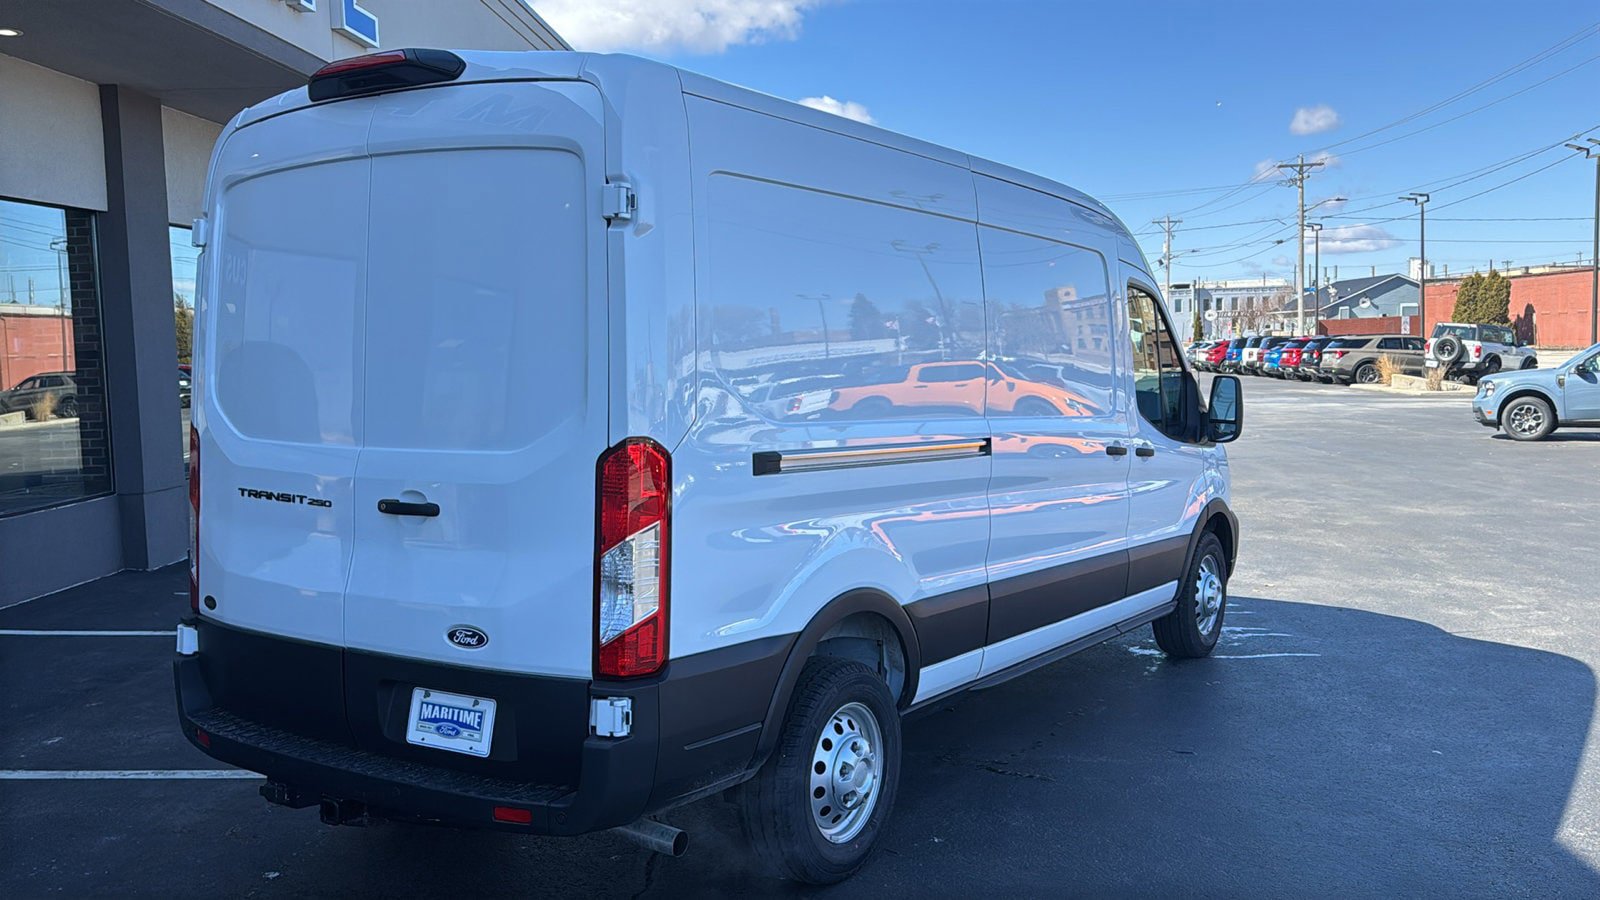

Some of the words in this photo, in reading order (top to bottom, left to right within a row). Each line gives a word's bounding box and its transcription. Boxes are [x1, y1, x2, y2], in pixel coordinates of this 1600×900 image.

[238, 487, 307, 504] TRANSIT
[307, 498, 332, 508] 250
[453, 629, 479, 645] Ford
[420, 703, 482, 730] MARITIME
[438, 724, 458, 737] Ford
